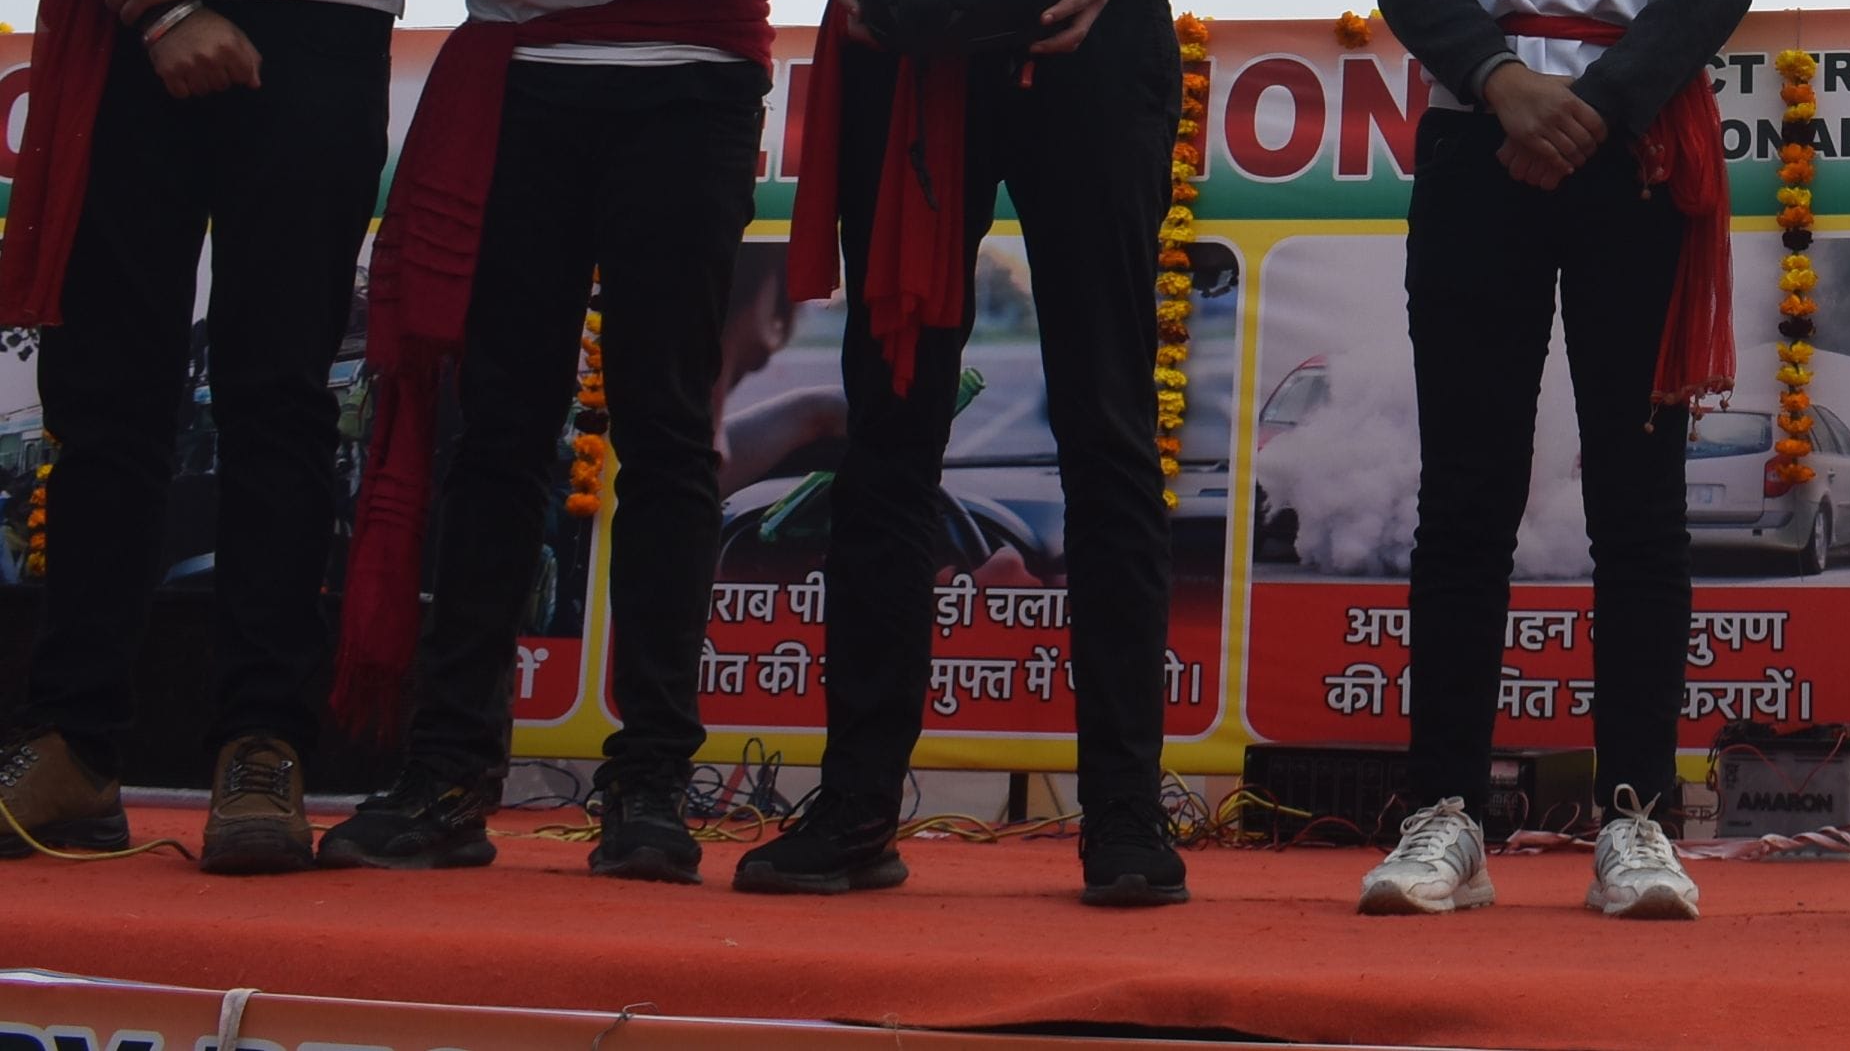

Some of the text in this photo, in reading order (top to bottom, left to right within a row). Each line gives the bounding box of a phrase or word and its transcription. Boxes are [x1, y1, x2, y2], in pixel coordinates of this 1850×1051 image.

[757, 641, 811, 694] की
[1024, 646, 1059, 700] में
[1325, 663, 1387, 715] की
